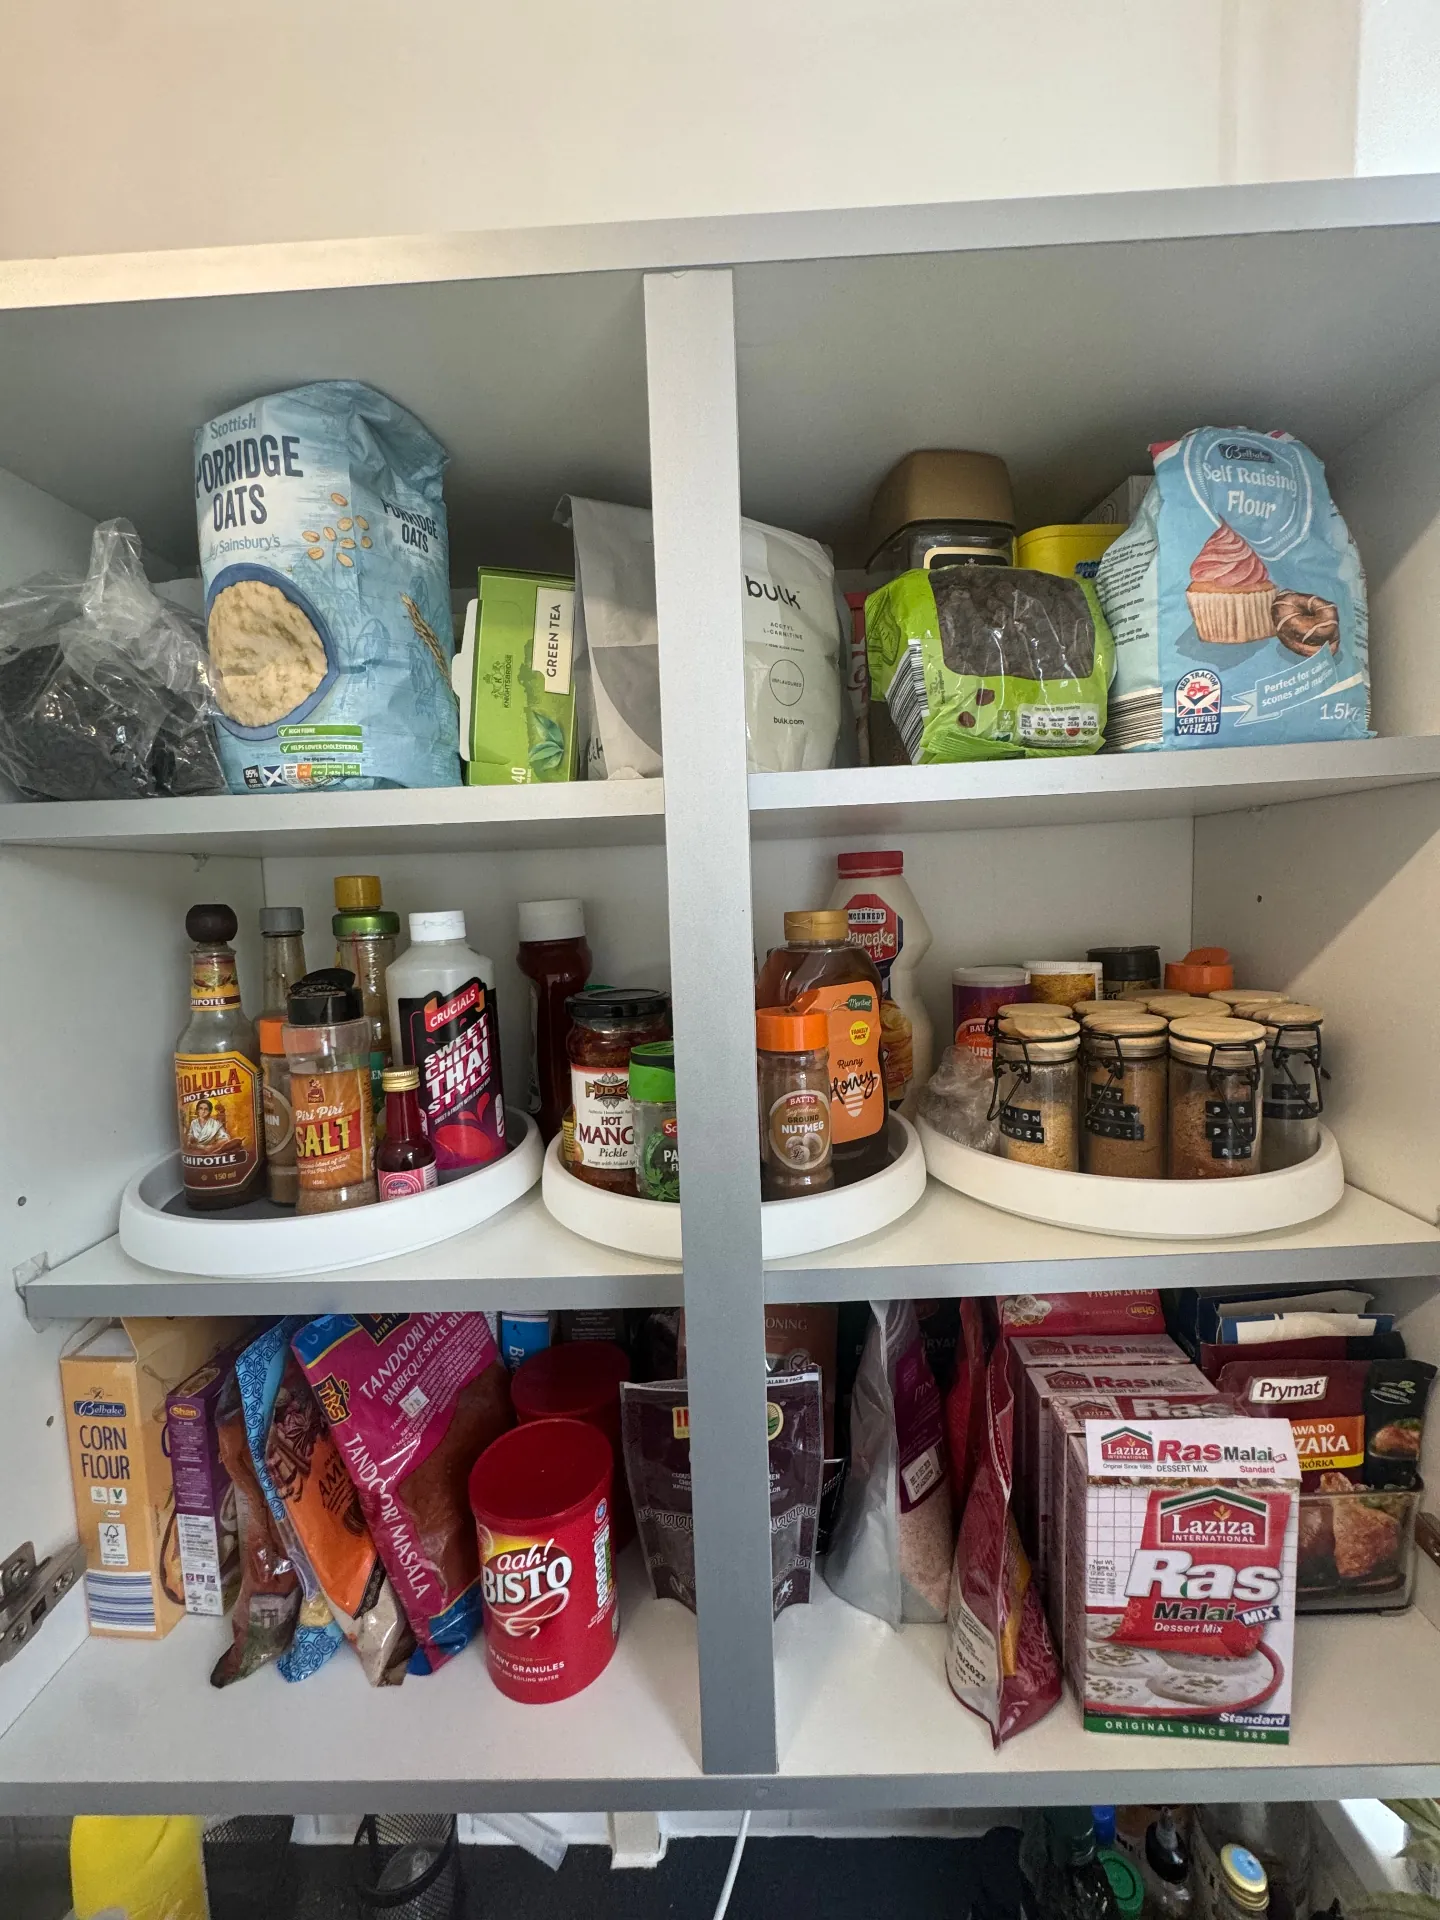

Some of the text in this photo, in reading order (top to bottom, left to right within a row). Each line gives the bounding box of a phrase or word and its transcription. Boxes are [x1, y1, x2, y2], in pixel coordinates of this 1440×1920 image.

[210, 412, 257, 440] Scottish
[1203, 460, 1297, 498] Self Raising
[213, 484, 267, 532] OATS
[1228, 490, 1276, 519] Flour
[219, 533, 281, 554] Sainsbury's
[401, 523, 429, 553] OATS
[745, 574, 801, 610] bulk
[770, 621, 795, 632] ACETYL
[546, 604, 561, 678] GREEN TEA
[504, 654, 513, 708] KNIGHTSBRIDGE
[1179, 671, 1219, 692] RED TRACTOR
[1264, 677, 1297, 695] Perfect
[1297, 669, 1310, 683] for
[1262, 690, 1293, 707] scones
[1294, 682, 1310, 696] and
[773, 716, 805, 725] bulk.com
[1176, 723, 1218, 735] WHEAT
[1179, 715, 1218, 725] CERTIFIED
[304, 743, 322, 751] LOWER
[322, 743, 359, 751] CHOLESTEROL
[511, 767, 527, 784] 40
[429, 988, 476, 1028] CRUCIALS
[424, 1013, 488, 1067] SWEET
[851, 1027, 868, 1036] FAMILY
[854, 1033, 867, 1041] PACK
[425, 1026, 488, 1081] CHILLI
[837, 1058, 864, 1069] Runny
[426, 1038, 489, 1100] THAI
[183, 1087, 236, 1103] HOT SAUCE
[427, 1058, 490, 1115] STYLE
[585, 1080, 629, 1098] FUDC
[830, 1070, 877, 1105] Honey
[790, 1096, 815, 1106] BATTS
[295, 1102, 345, 1122] Piri Piri
[601, 1116, 622, 1126] HOT
[787, 1114, 819, 1123] GROUND
[295, 1114, 353, 1158] SALT
[781, 1121, 824, 1134] NUTMEG
[182, 1154, 237, 1166] CHIPOTLE
[599, 1147, 628, 1158] Pickle
[214, 1173, 227, 1181] 150
[1130, 1306, 1156, 1315] Shan
[1071, 1344, 1124, 1354] Ras
[359, 1322, 428, 1400] TANDOORI
[382, 1350, 426, 1406] BARBEQUE
[422, 1325, 449, 1357] SPICE
[789, 1374, 803, 1382] PACK
[1092, 1376, 1150, 1388] Ras
[318, 1381, 348, 1422] TRS
[1259, 1381, 1320, 1402] Prymat
[78, 1400, 124, 1417] Belbake
[171, 1406, 197, 1417] Shan
[1079, 1399, 1237, 1419] Laziza Ras
[80, 1424, 128, 1450] CORN
[1317, 1423, 1335, 1433] DO
[1107, 1443, 1149, 1456] Laziza
[1157, 1440, 1222, 1462] Ras
[1224, 1446, 1274, 1461] Malai
[81, 1453, 130, 1480] FLOUR
[1157, 1464, 1276, 1474] DESSERT MIX Standard
[1172, 1514, 1256, 1537] Laziza
[1172, 1535, 1256, 1543] INTERNATIONAL
[390, 1523, 431, 1600] MASALA
[496, 1538, 555, 1572] aah!
[482, 1556, 573, 1605] BISTO
[1124, 1549, 1282, 1602] Ras
[1153, 1601, 1237, 1622] Malai
[1240, 1606, 1278, 1626] MIX
[1154, 1622, 1224, 1634] Dessert Mix
[511, 1660, 565, 1673] GRANULES
[512, 1673, 536, 1682] BOILING
[537, 1673, 559, 1682] WATER
[1219, 1712, 1286, 1726] Standard
[1105, 1720, 1267, 1740] ORIGINAL SINCE 1985
